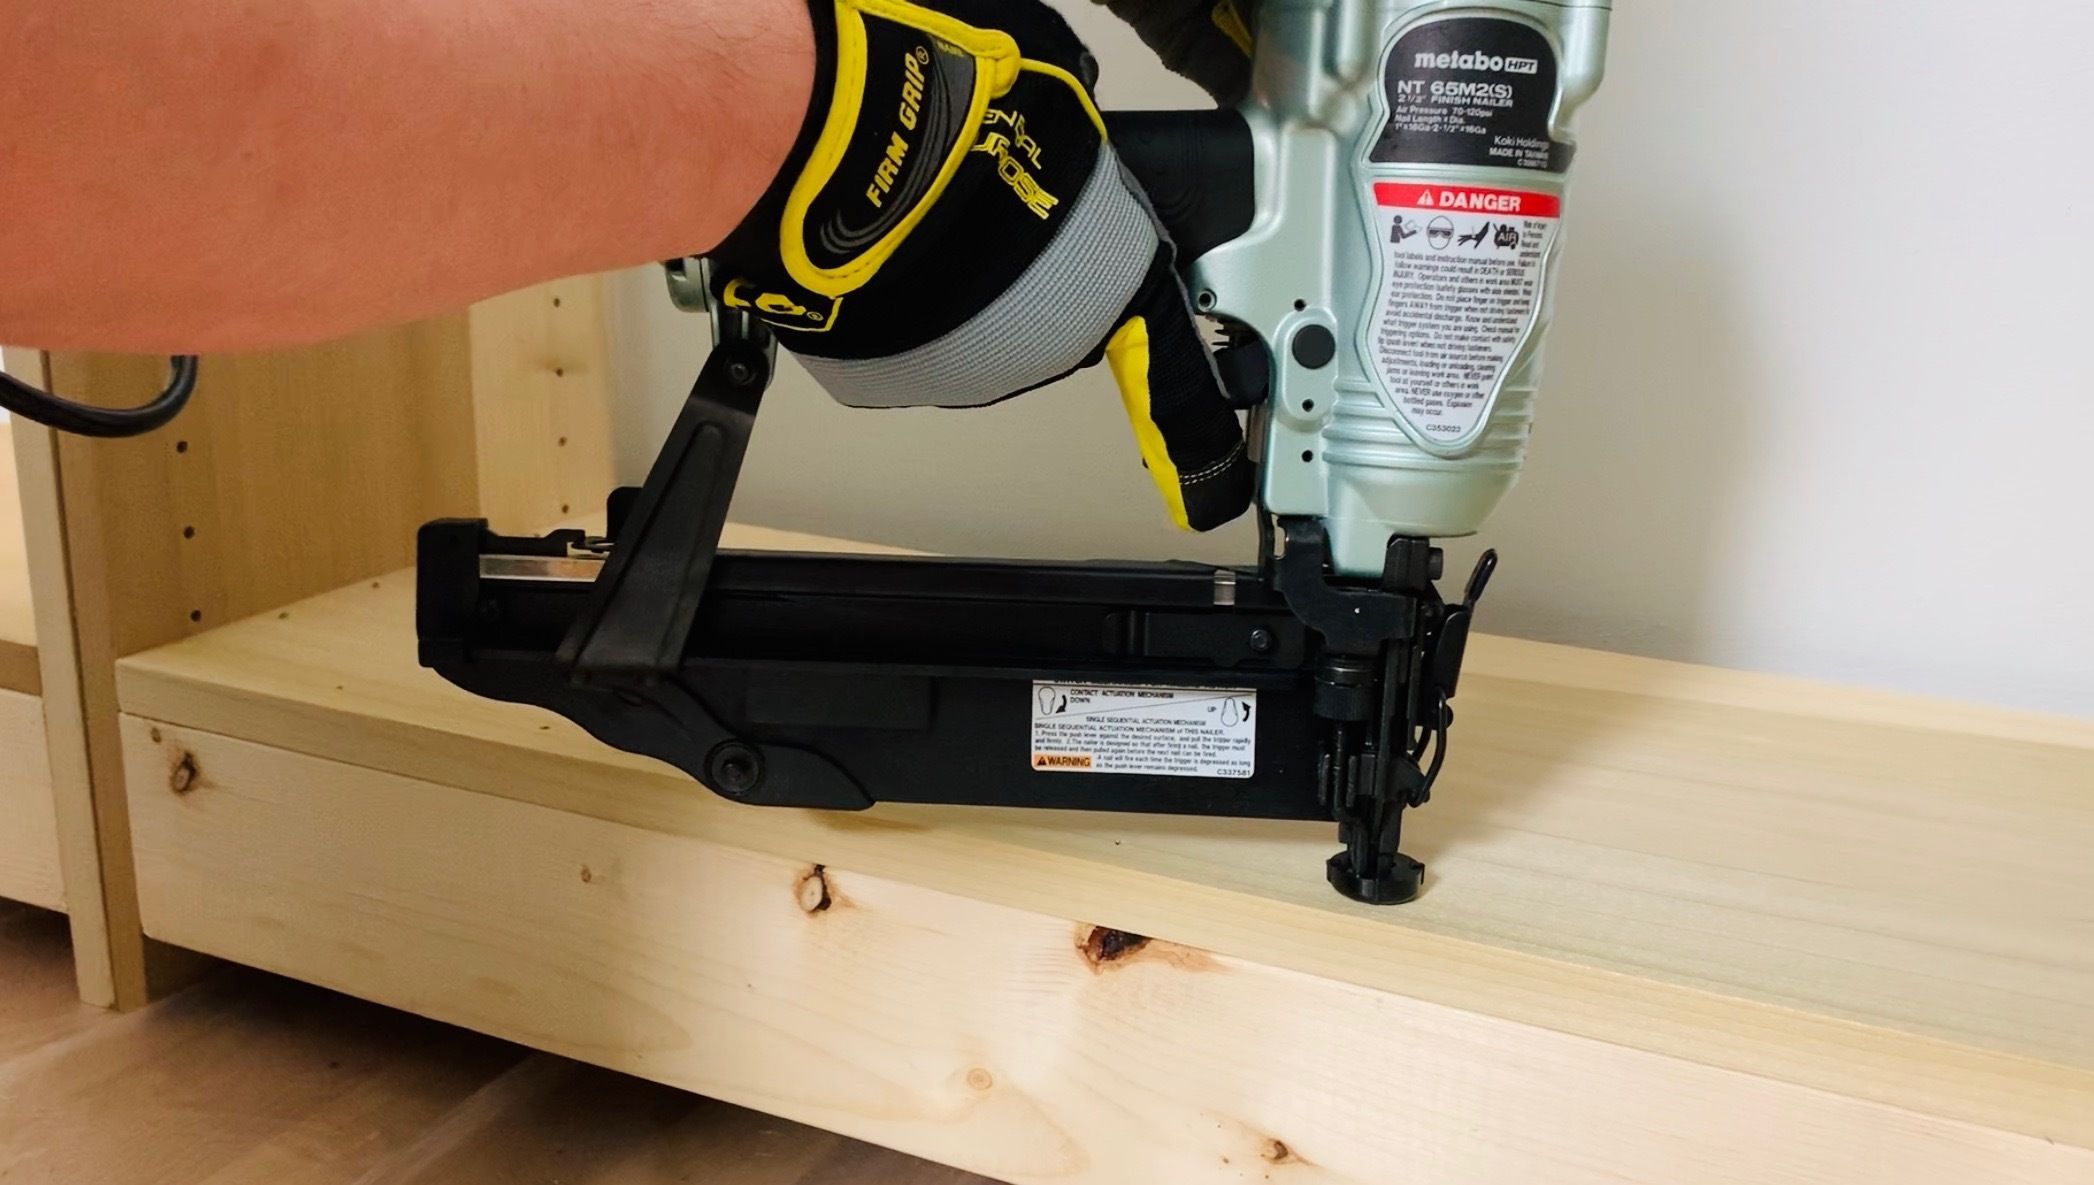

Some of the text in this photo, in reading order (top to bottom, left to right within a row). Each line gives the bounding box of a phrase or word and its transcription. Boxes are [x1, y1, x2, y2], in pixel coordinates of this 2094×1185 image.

[1414, 50, 1537, 73] metabo HPT
[1397, 80, 1513, 98] NT 65M2(S)
[1431, 95, 1470, 105] FINISH
[1473, 98, 1513, 107] NAILER
[1396, 105, 1409, 113] Air
[1409, 105, 1448, 115] Pressure
[1489, 147, 1514, 157] MADE
[865, 132, 908, 207] FIRM
[1439, 192, 1521, 212] DANGER
[1498, 232, 1516, 243] AIR
[1047, 756, 1091, 767] WARNING
